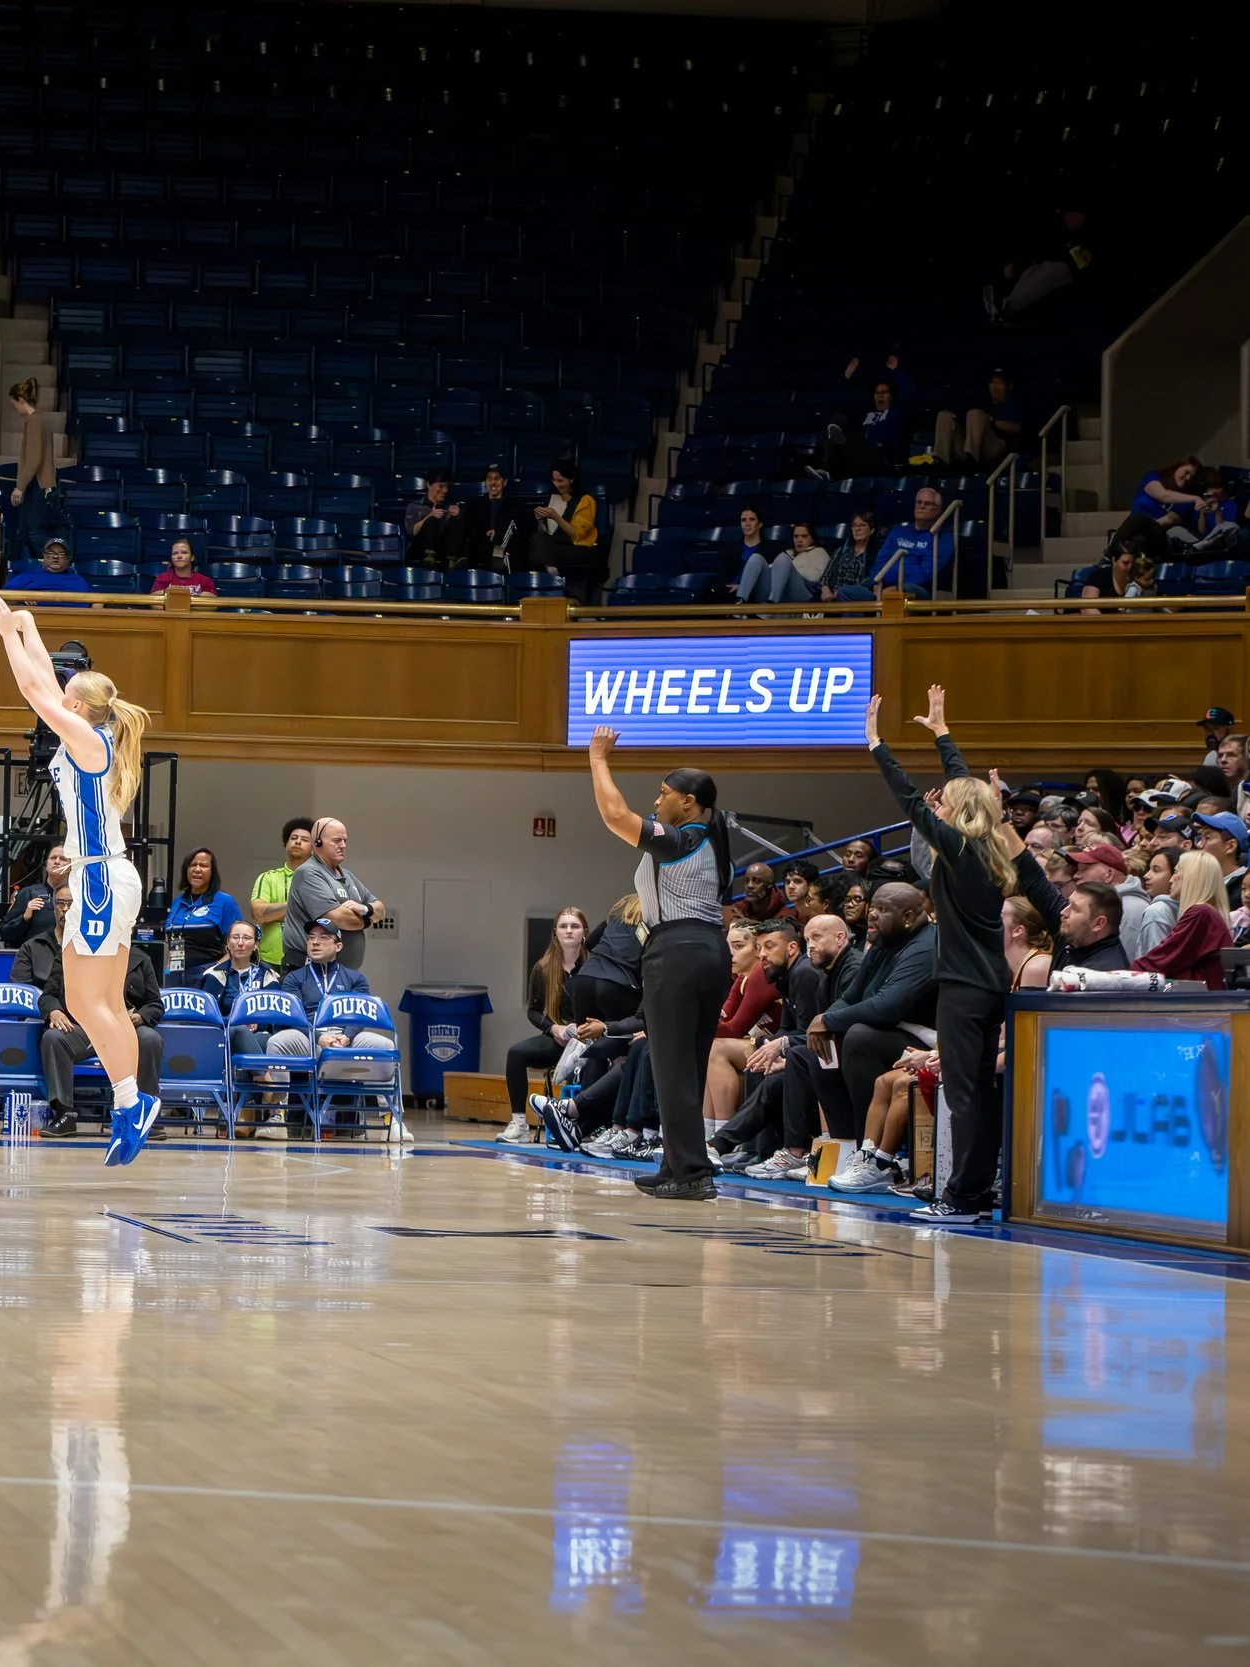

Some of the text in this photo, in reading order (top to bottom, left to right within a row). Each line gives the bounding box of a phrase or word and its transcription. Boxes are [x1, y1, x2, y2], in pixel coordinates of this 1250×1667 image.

[584, 667, 854, 715] WHEELS UP
[161, 992, 206, 1015] DUKE
[246, 991, 291, 1016] DUKE
[332, 997, 378, 1021] DUKE
